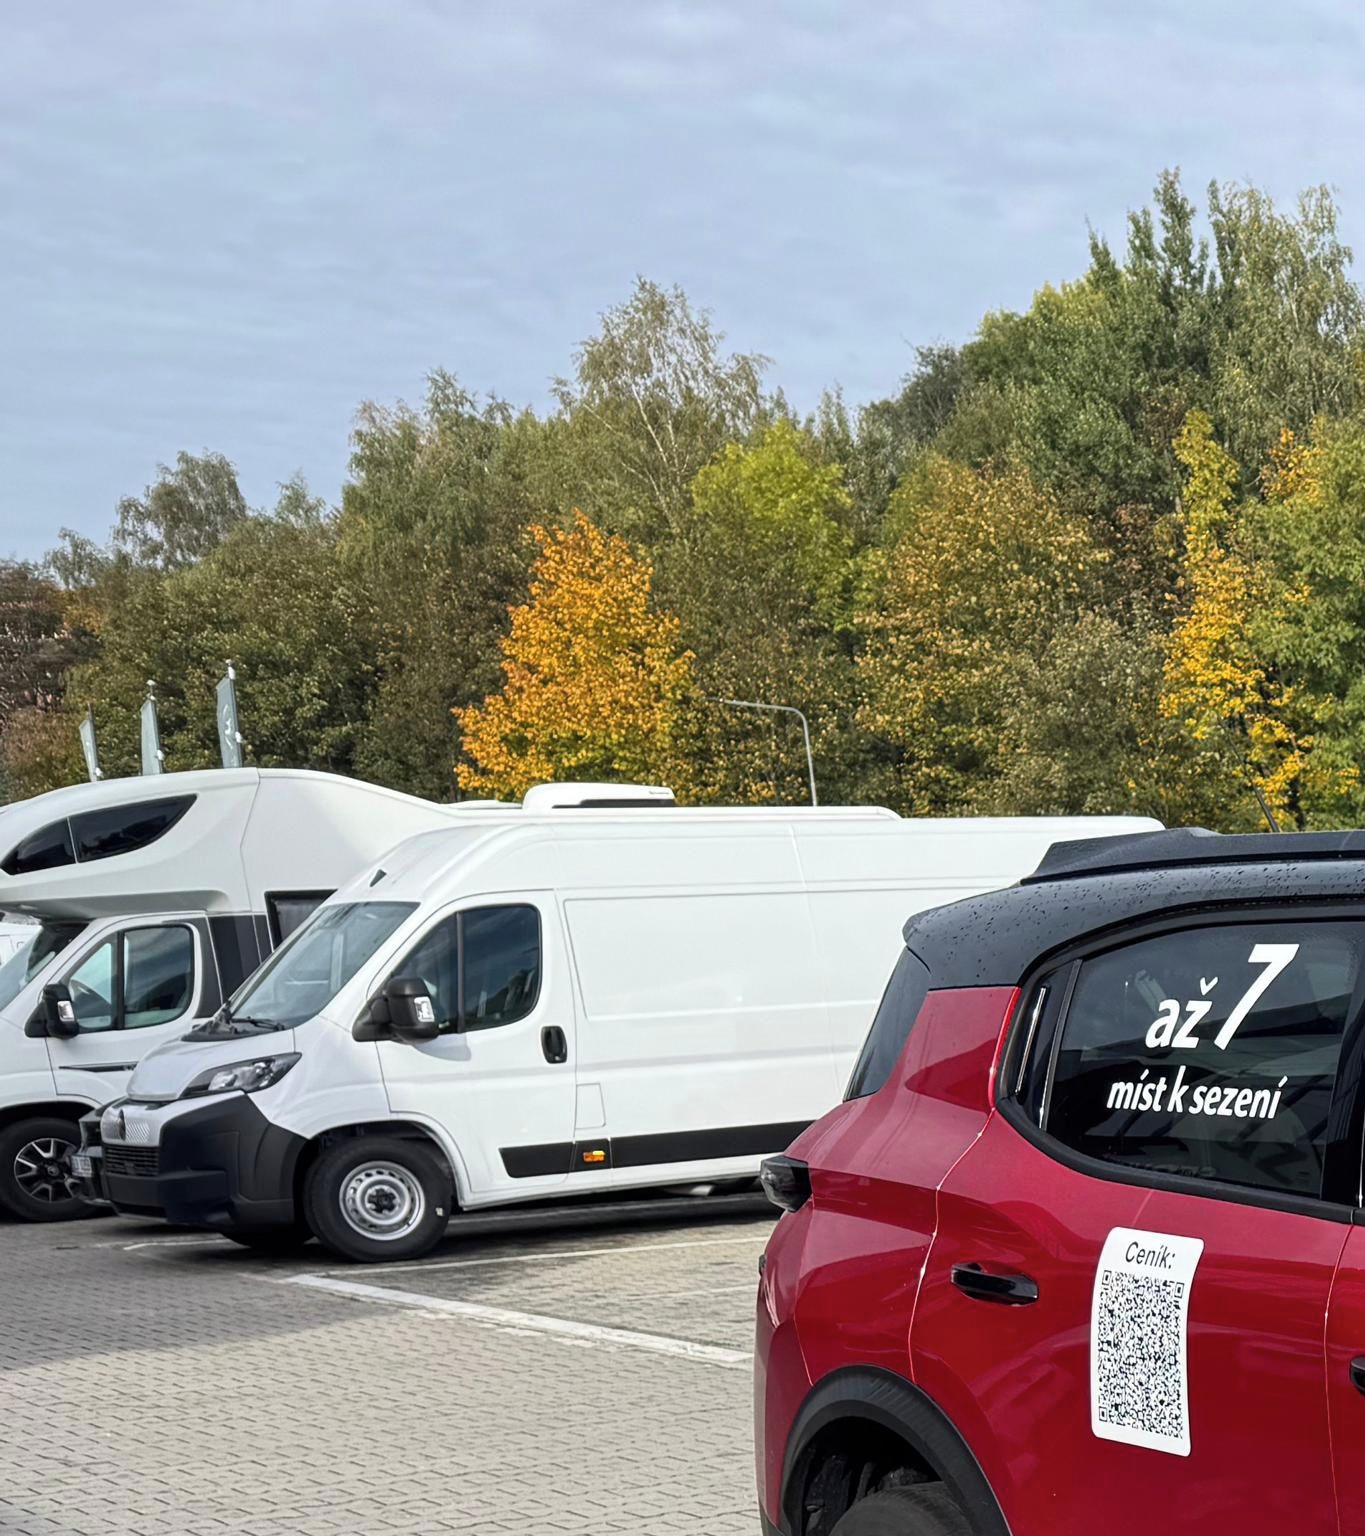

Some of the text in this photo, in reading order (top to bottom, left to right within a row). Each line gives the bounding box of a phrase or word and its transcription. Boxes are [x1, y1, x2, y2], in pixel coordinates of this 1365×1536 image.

[1145, 943, 1300, 1051] až 7
[1106, 1064, 1289, 1119] míst k sezení
[1125, 1241, 1176, 1270] Ceník:
